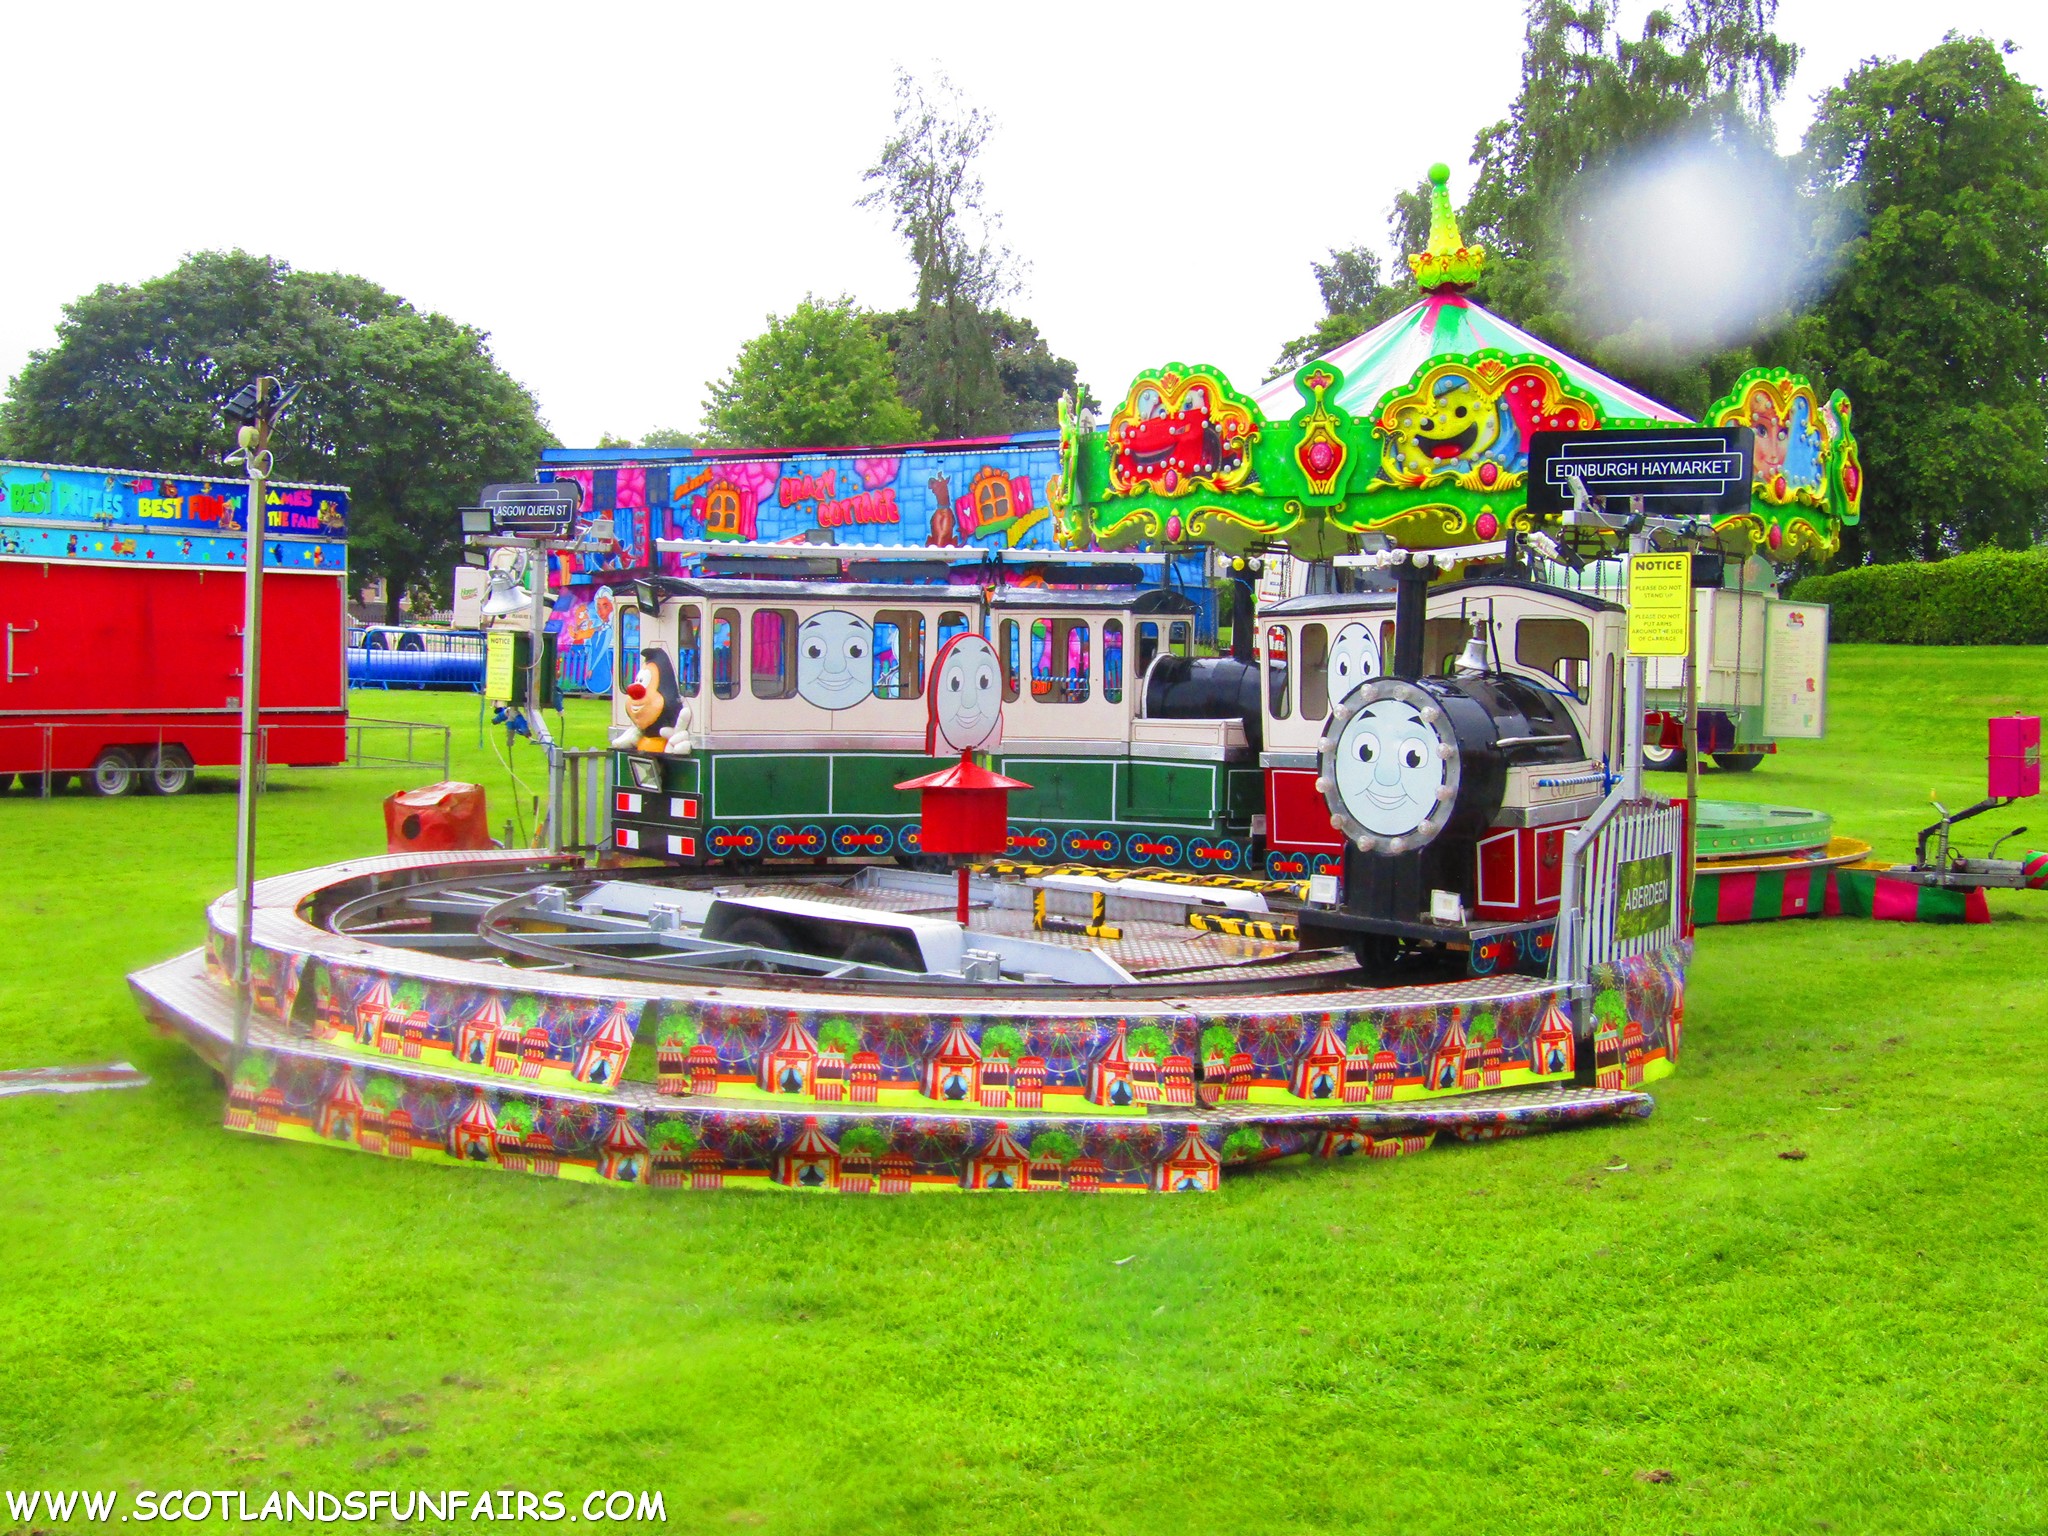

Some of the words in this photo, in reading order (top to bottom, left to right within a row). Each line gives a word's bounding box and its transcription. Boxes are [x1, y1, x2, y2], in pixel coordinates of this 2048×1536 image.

[1555, 462, 1638, 478] EDINBURGH
[1641, 459, 1732, 475] HAYMARKET
[10, 482, 54, 514] BEST
[57, 483, 123, 519] PRIZES
[779, 468, 836, 508] CRAZY
[138, 497, 183, 519] BEST
[188, 494, 224, 521] FUN
[265, 489, 313, 508] AMES
[493, 505, 526, 517] LASGOW
[527, 504, 555, 516] QUEEN
[556, 504, 567, 516] ST
[817, 488, 900, 527] COTTAGE
[267, 511, 289, 527] THE
[291, 513, 320, 529] FAIR
[1635, 560, 1682, 571] NOTICE
[490, 637, 511, 645] NOTICE
[1624, 878, 1669, 911] ABERDEEN
